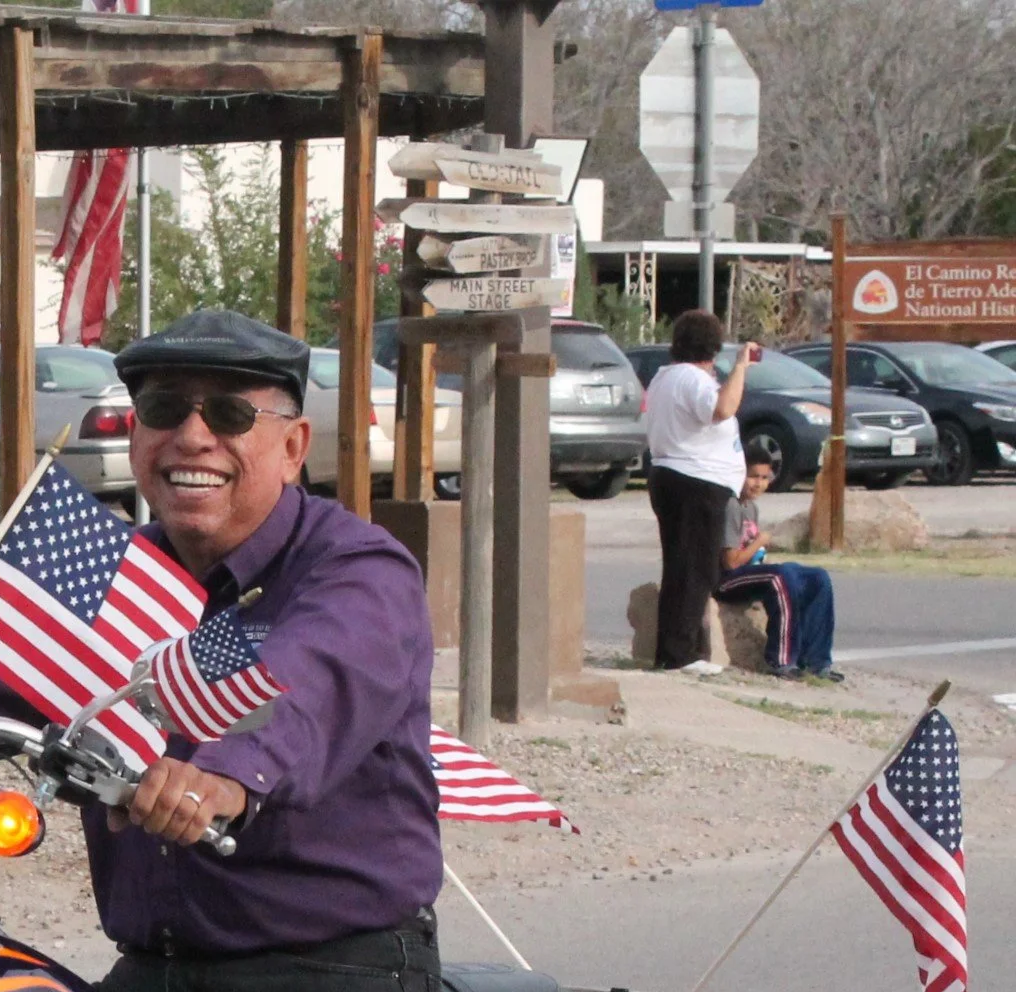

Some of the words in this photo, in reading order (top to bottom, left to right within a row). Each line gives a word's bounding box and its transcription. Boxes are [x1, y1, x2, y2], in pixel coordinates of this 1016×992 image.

[505, 165, 541, 188] JAIL
[480, 252, 514, 270] PASTRY
[905, 265, 922, 280] El
[926, 265, 991, 280] Camino
[450, 281, 482, 293] MAIN
[487, 280, 534, 293] STREET
[904, 284, 924, 299] de
[929, 283, 982, 299] Tierro
[468, 294, 512, 309] STAGE
[905, 302, 976, 317] National
